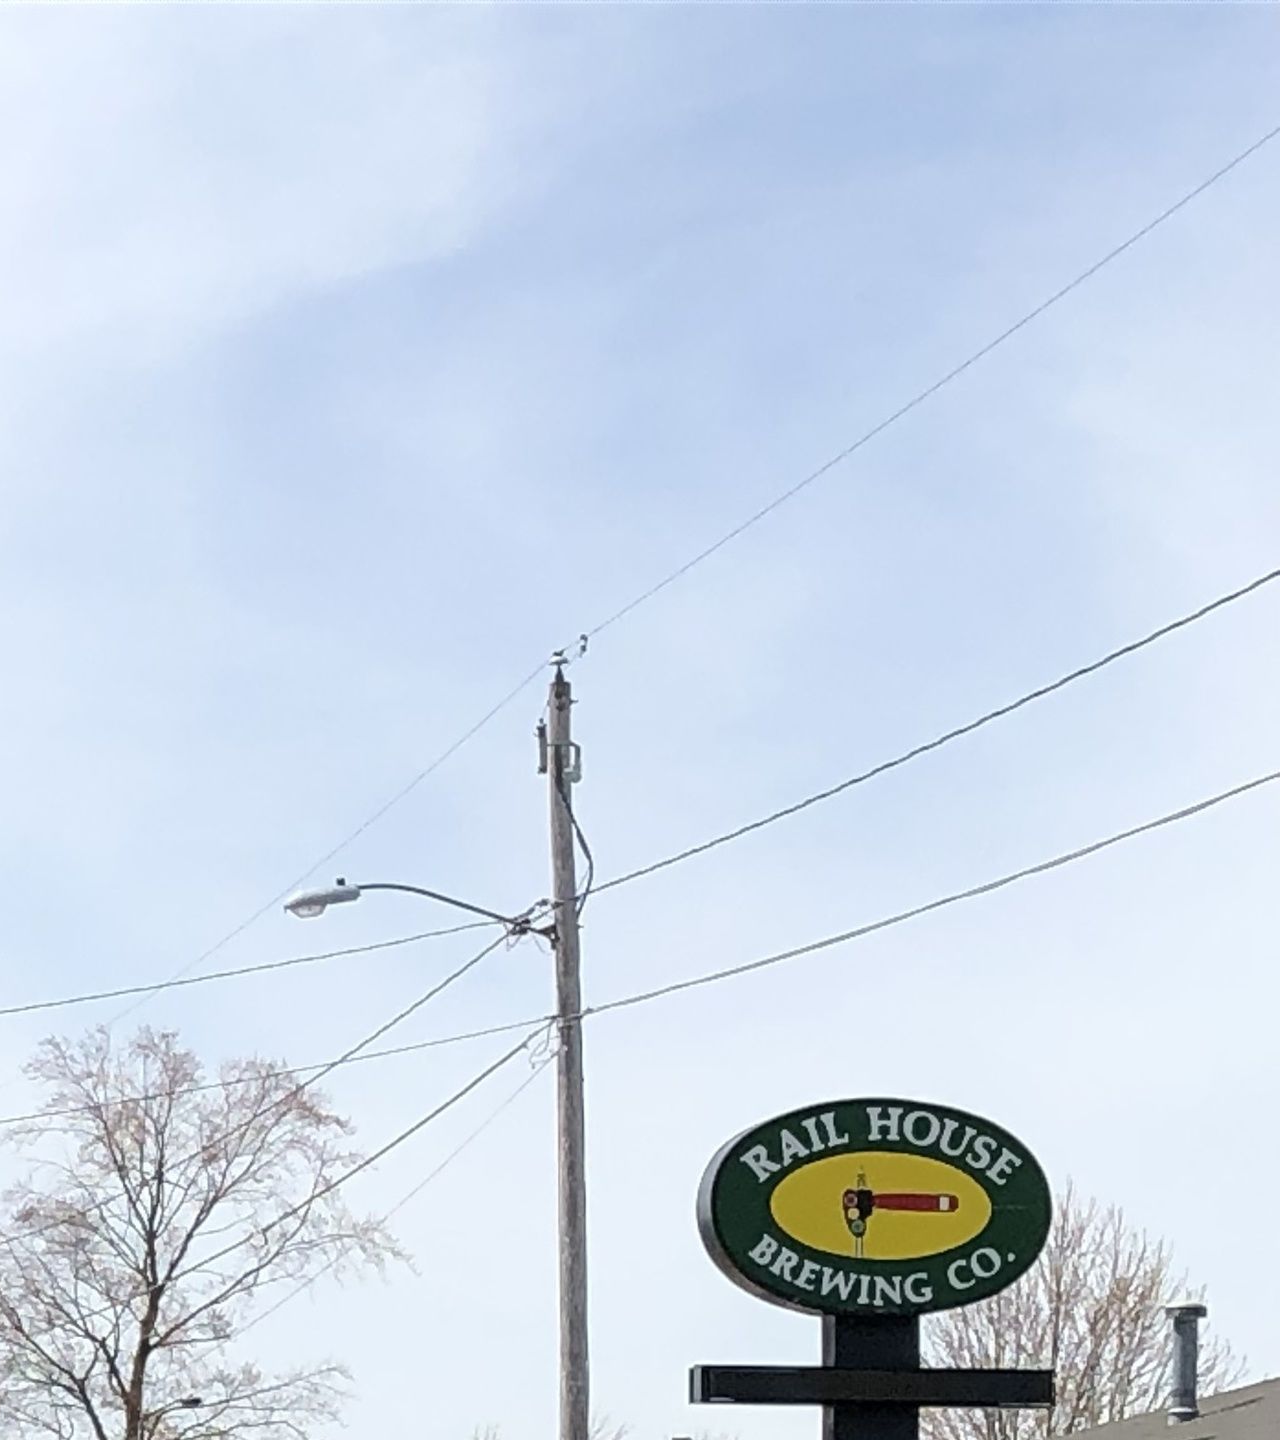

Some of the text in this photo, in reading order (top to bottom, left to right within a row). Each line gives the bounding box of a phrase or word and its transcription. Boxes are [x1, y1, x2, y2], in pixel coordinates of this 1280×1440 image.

[739, 1106, 1023, 1186] RAIL HOUSE
[748, 1233, 1016, 1306] BREWING CO.
